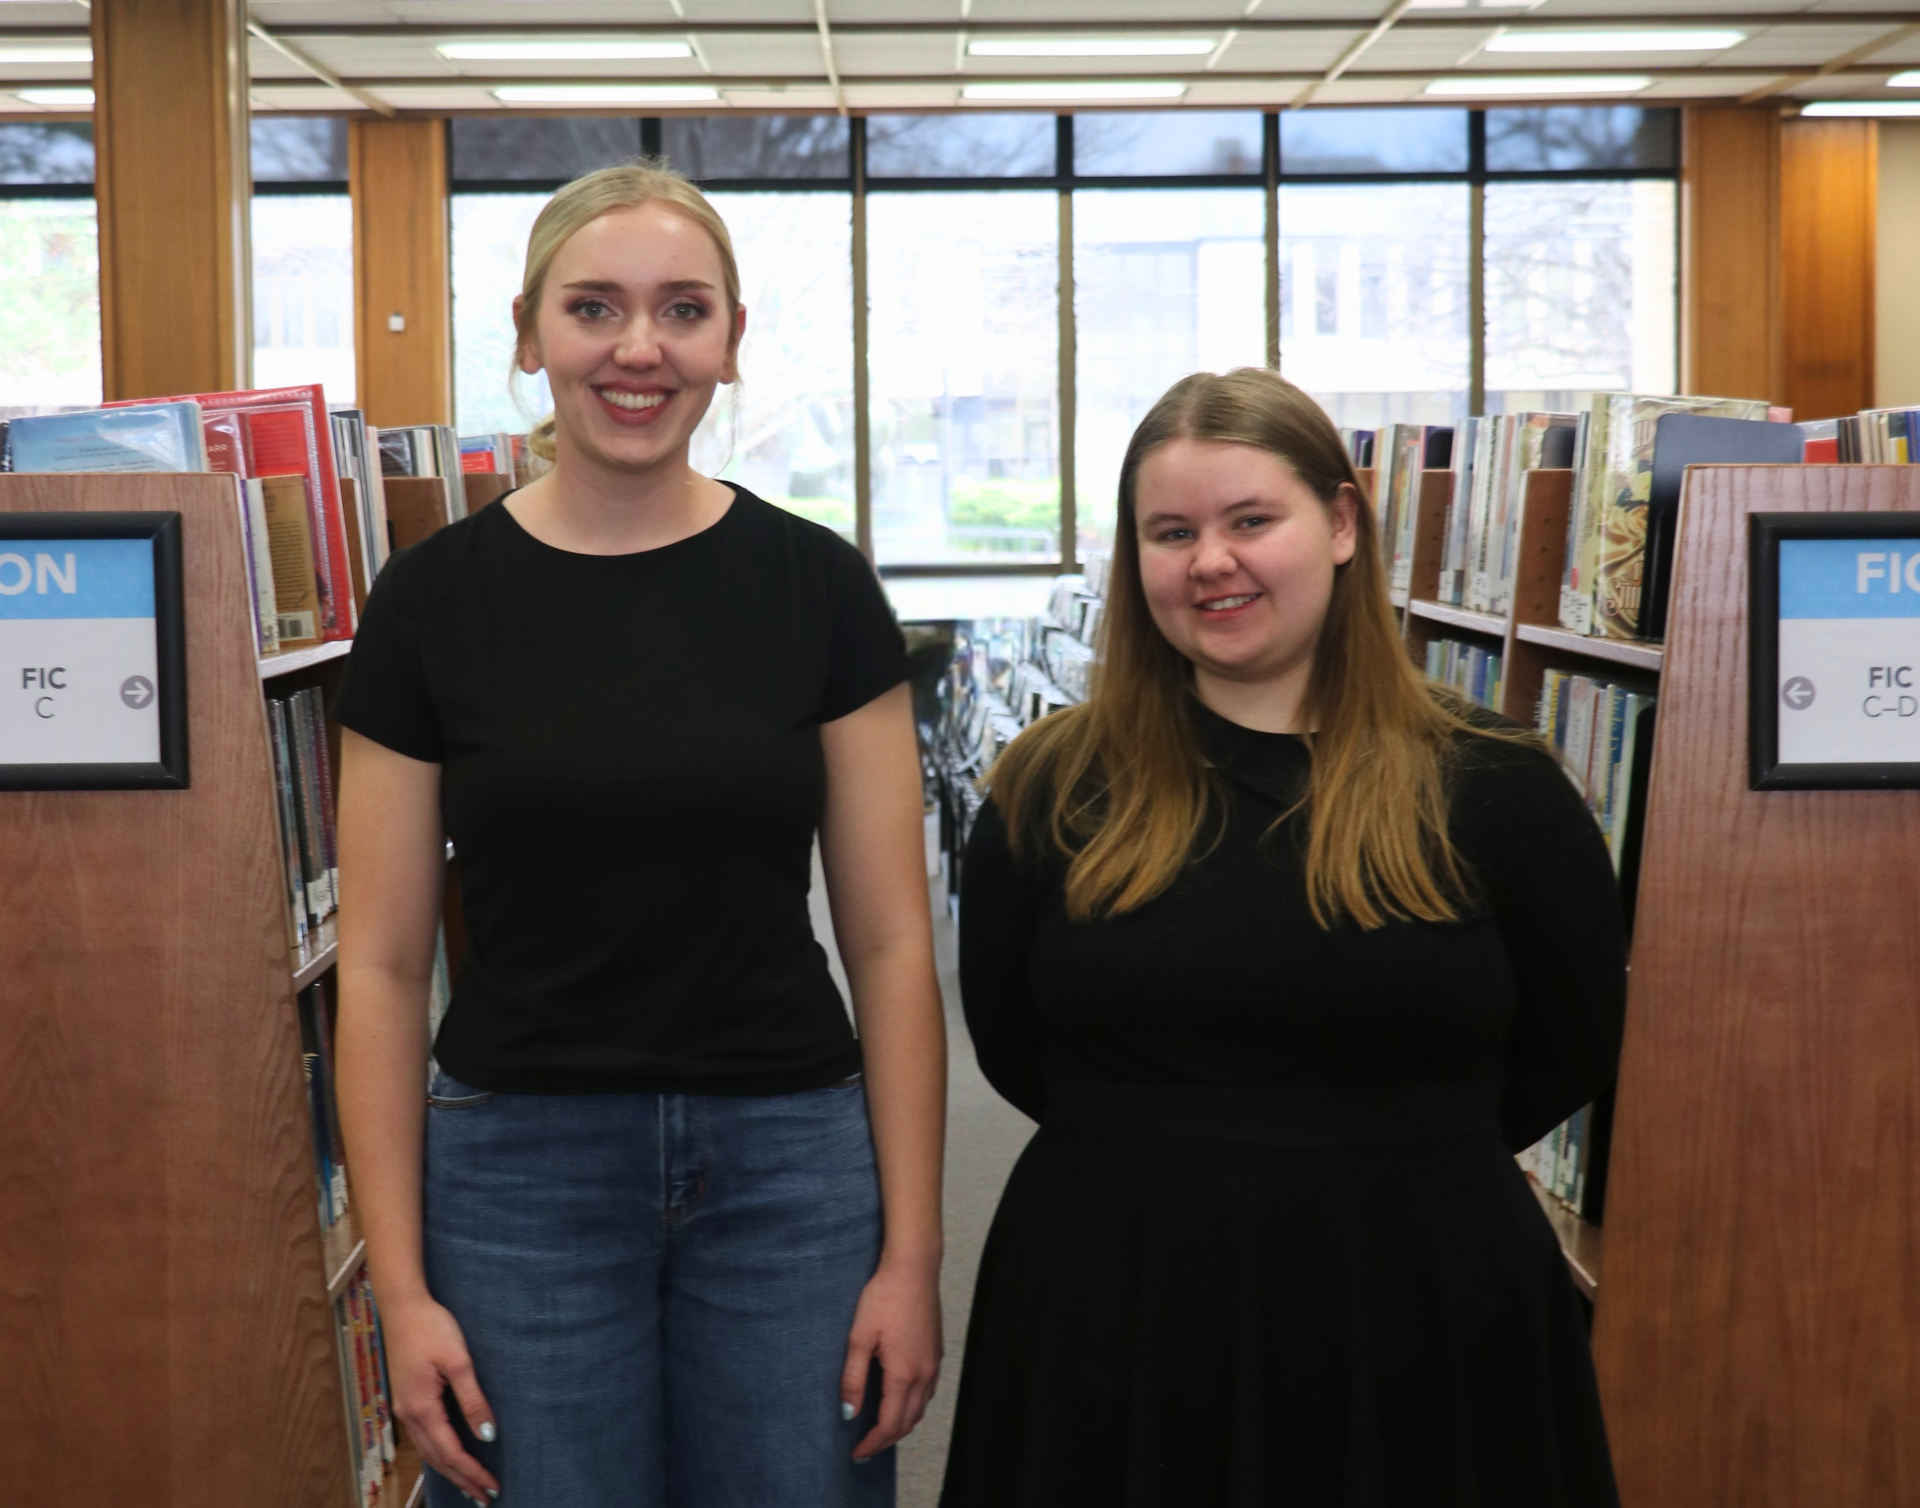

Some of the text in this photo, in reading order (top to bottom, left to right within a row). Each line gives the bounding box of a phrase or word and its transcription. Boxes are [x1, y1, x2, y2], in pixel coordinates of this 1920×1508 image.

[0, 553, 77, 595] ON
[22, 667, 67, 689] FIC
[1869, 666, 1914, 688] FIC
[35, 696, 55, 719] C
